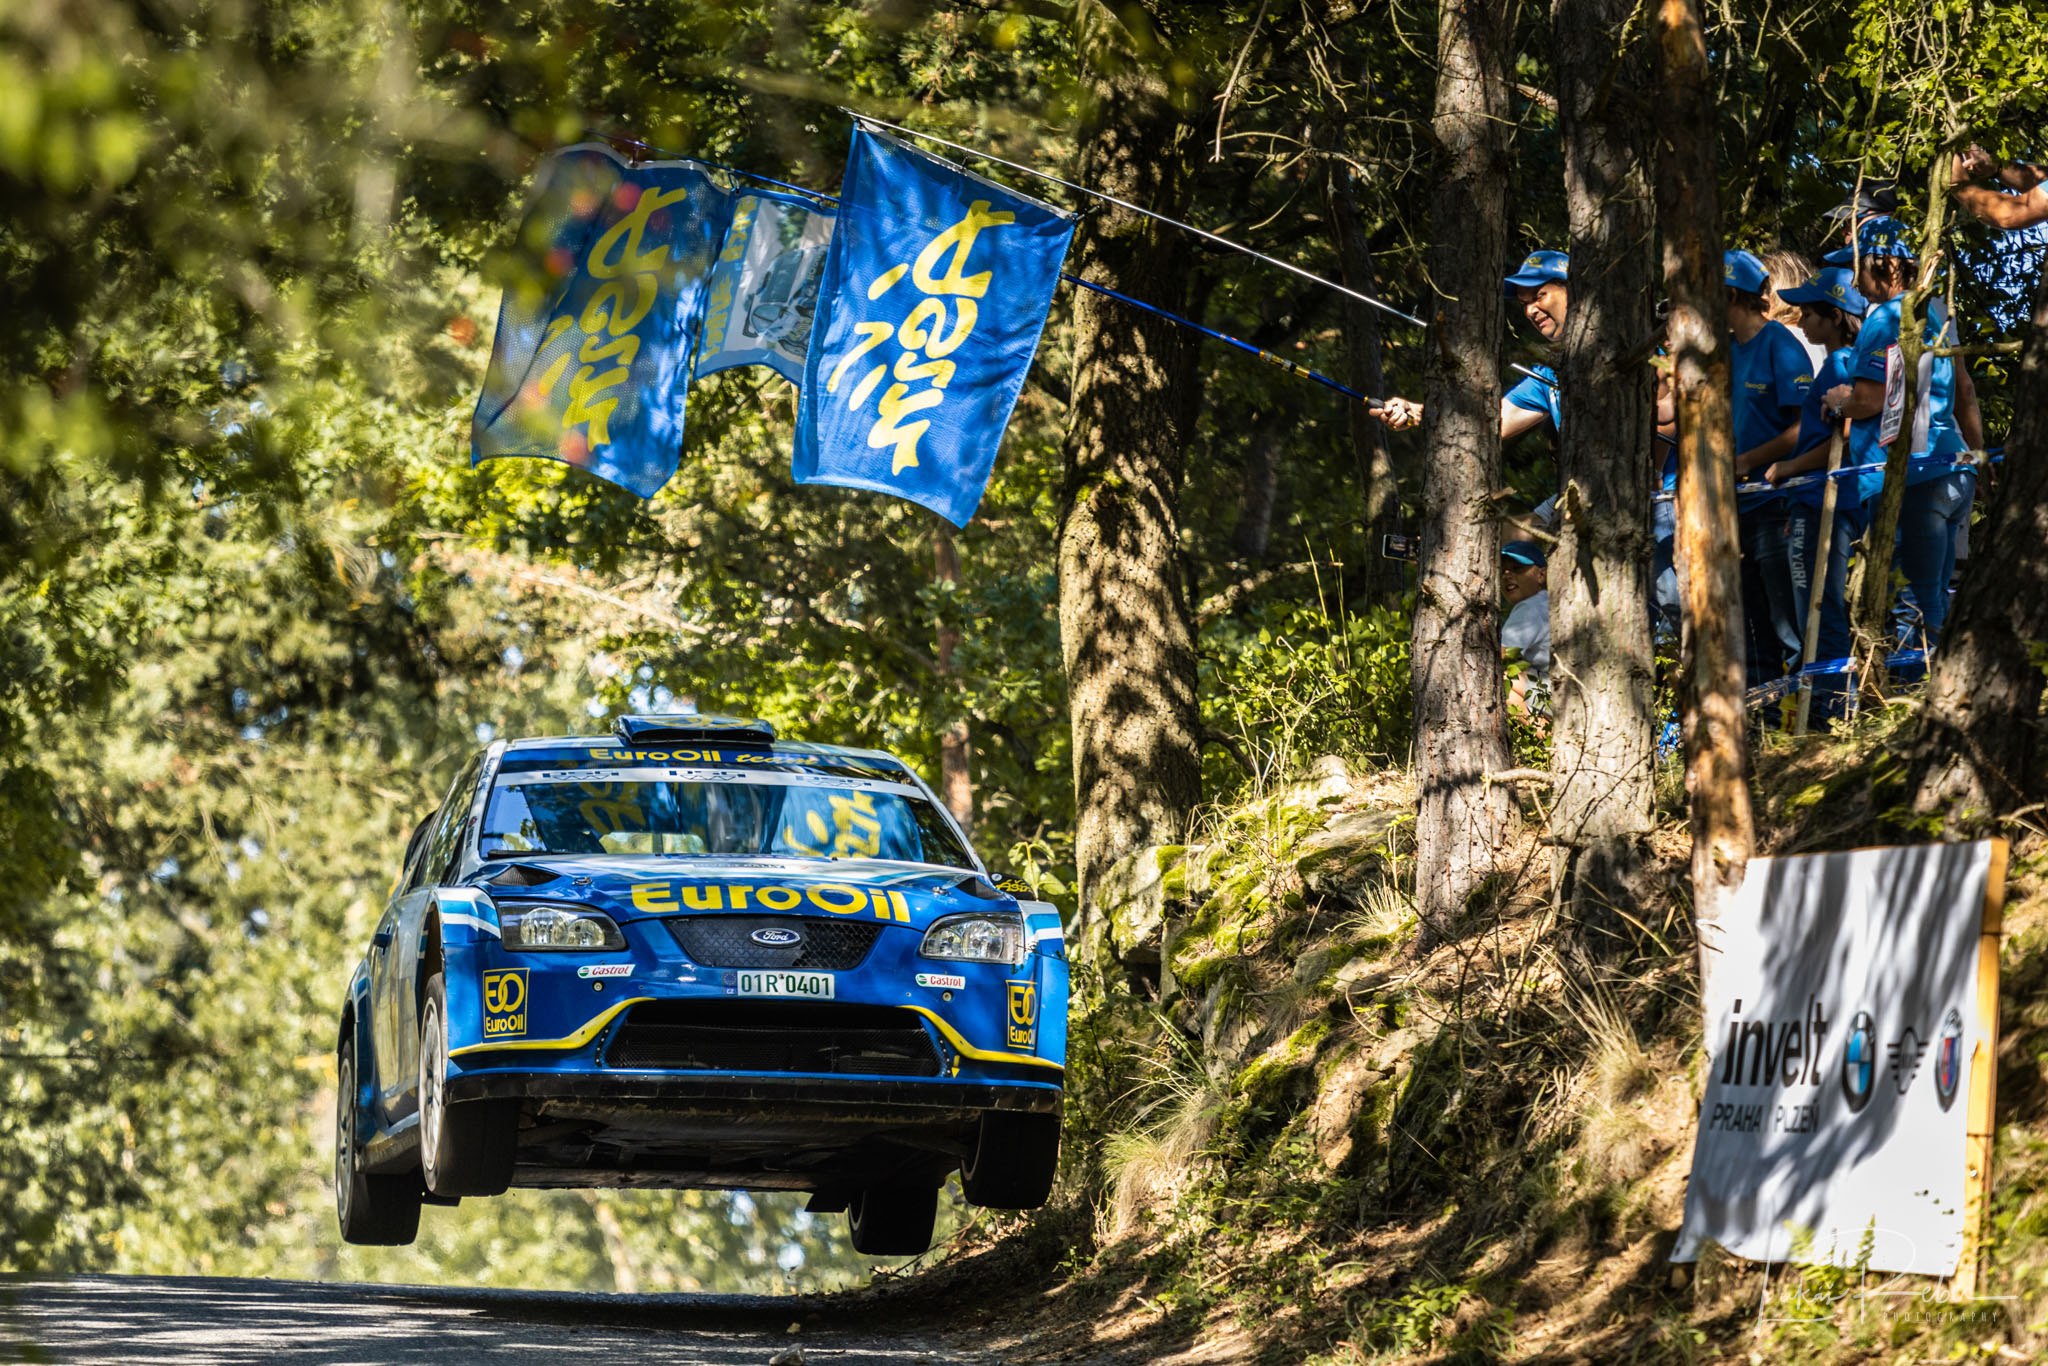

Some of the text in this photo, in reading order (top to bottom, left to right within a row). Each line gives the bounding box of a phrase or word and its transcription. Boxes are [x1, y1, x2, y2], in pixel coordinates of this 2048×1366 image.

[1791, 519, 1807, 588] NEW YORK
[590, 748, 721, 763] EuroOil
[631, 882, 910, 922] EuroOil
[762, 930, 788, 942] Ford
[592, 966, 629, 976] Castrol
[930, 975, 962, 987] Castrol
[486, 1014, 524, 1032] EuroOil
[1721, 994, 1827, 1087] invelt
[1709, 1103, 1763, 1132] PRAHA
